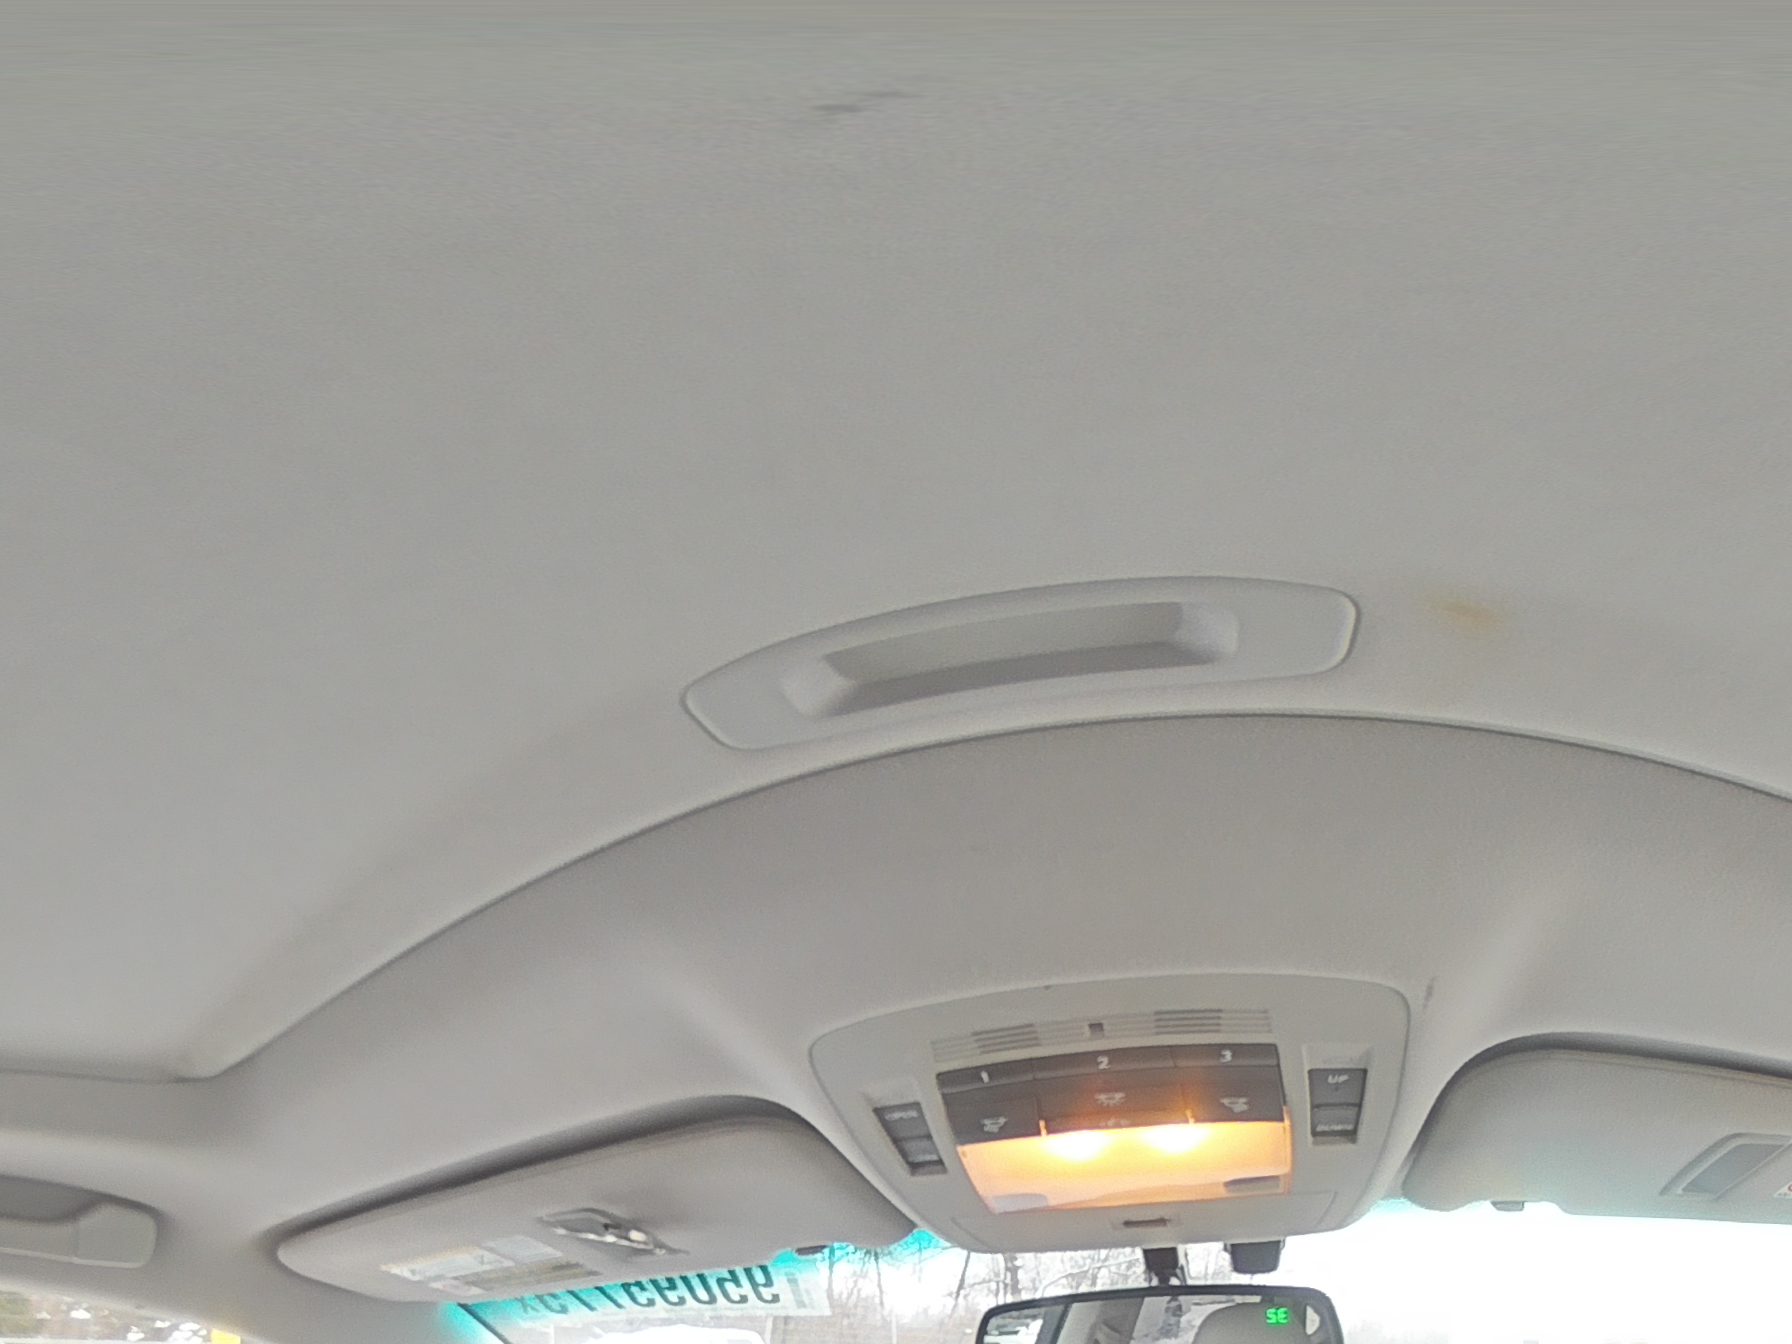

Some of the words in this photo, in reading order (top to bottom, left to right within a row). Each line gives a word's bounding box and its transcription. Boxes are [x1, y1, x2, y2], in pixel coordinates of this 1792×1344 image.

[1097, 1055, 1111, 1070] 2
[1220, 1049, 1233, 1063] 3
[980, 1070, 990, 1084] 1
